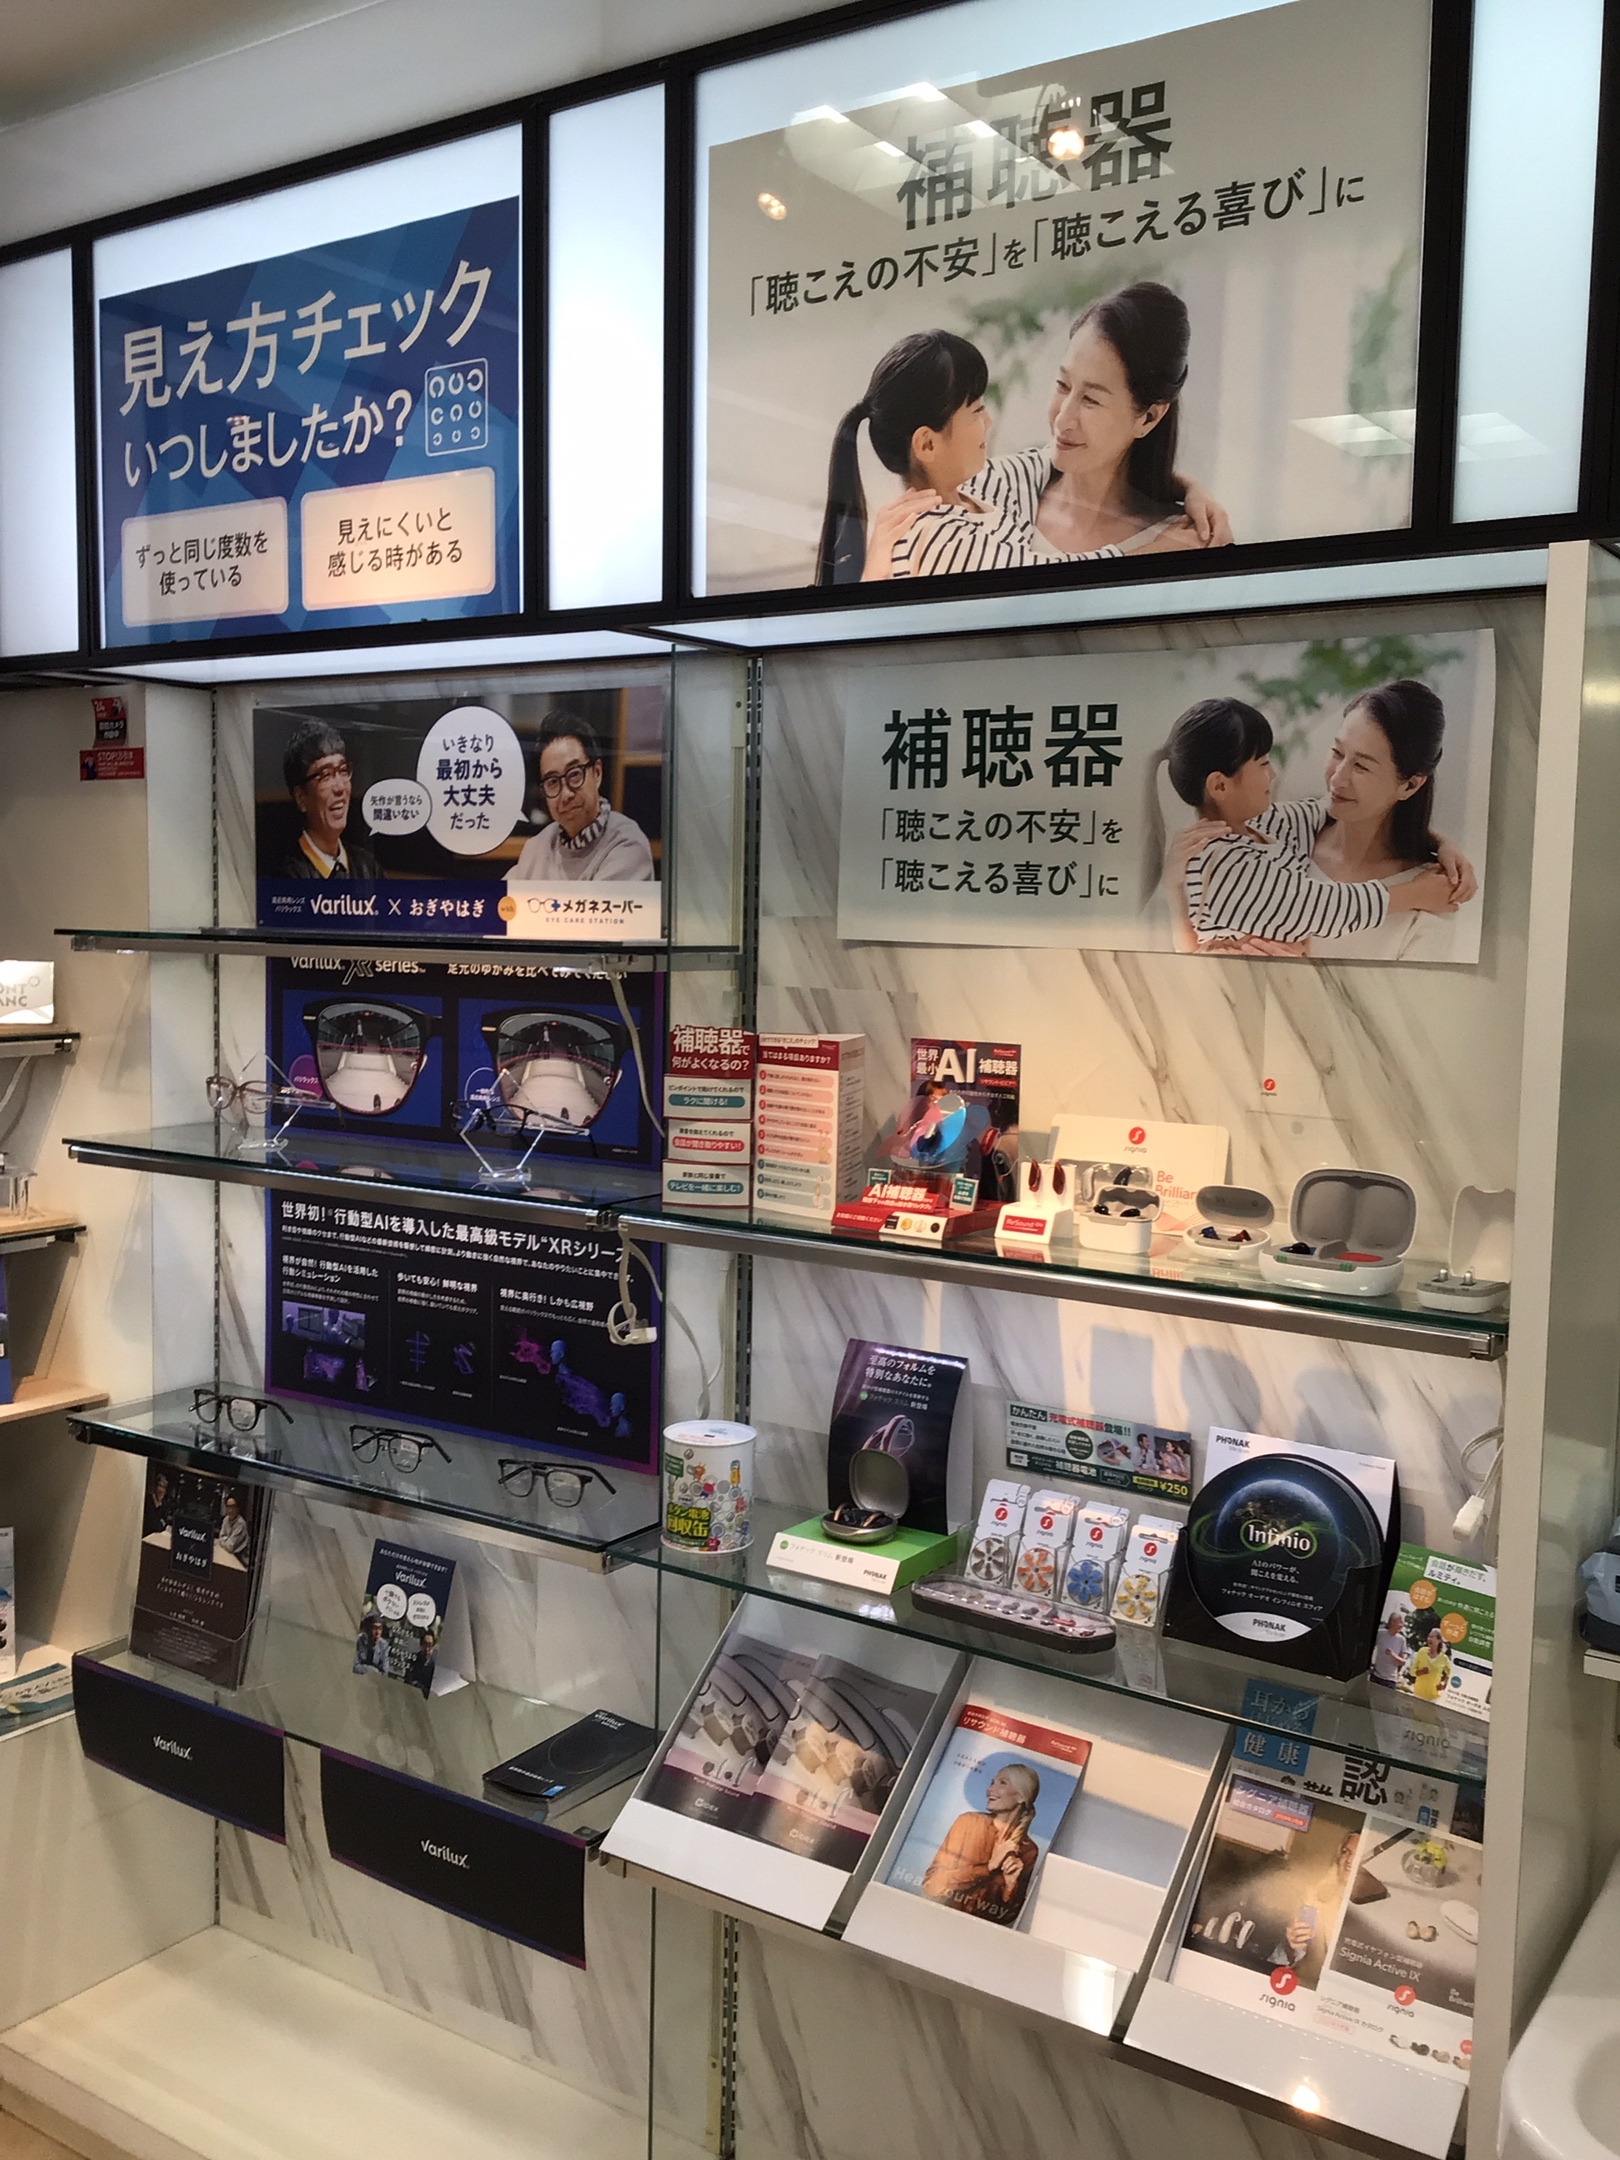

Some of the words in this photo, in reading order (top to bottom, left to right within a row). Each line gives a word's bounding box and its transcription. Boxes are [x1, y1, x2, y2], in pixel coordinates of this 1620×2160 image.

[897, 81, 1173, 230] 補聴器
[750, 167, 1365, 317] 「聴こえの不安」を「聴こえる喜び」に
[119, 260, 491, 416] 見え方チェック
[124, 389, 412, 487] いつしましたか？
[338, 507, 452, 546] 見えにくいと
[136, 530, 268, 569] ずっと同じ度数を
[328, 541, 462, 579] 感じる時がある
[159, 565, 242, 596] 使っている
[443, 734, 494, 753] いきなり
[882, 703, 1123, 790] 補聴器
[436, 757, 502, 780] 最初から
[443, 784, 495, 807] 大丈夫
[373, 808, 419, 821] 間違いない
[450, 812, 490, 829] だった
[881, 807, 1122, 846] 「聴こえの不安」を
[881, 857, 1119, 898] 「聴こえる喜び」に
[409, 898, 485, 917] おぎやはぎ
[563, 899, 643, 914] メガネスーパー
[673, 1026, 750, 1055] 補聴器で
[672, 1056, 749, 1071] 何がよくなるの？
[917, 1048, 938, 1060] 世界
[934, 1048, 977, 1083] AI
[979, 1058, 1018, 1076] 補聴器
[1157, 1171, 1173, 1183] Be
[1011, 1406, 1047, 1421] かんたん
[1216, 1435, 1250, 1449] PHONAK
[667, 1516, 709, 1537] 回収缶
[1252, 1618, 1286, 1632] PHONAK
[153, 1735, 191, 1760] Varilux
[420, 1839, 468, 1868] Varilux
[895, 1866, 923, 1886] Hea
[977, 1898, 1009, 1919] way
[1339, 1946, 1372, 1966] Signia
[1373, 1958, 1408, 1979] Active
[1259, 1993, 1296, 2012] signia
[1387, 2004, 1415, 2018] signia
